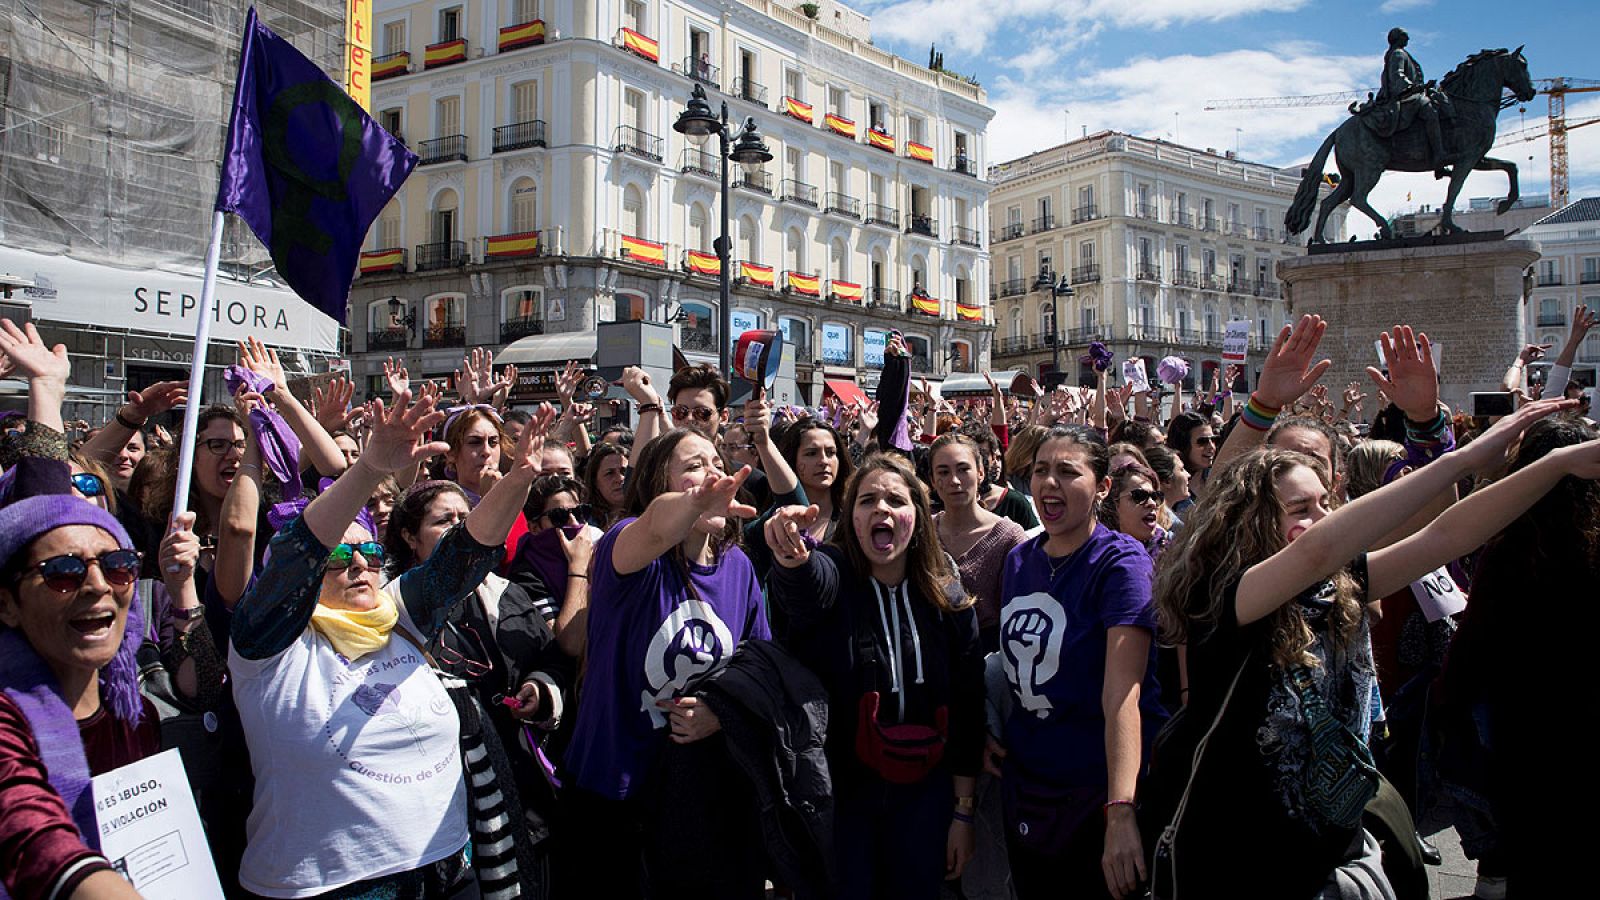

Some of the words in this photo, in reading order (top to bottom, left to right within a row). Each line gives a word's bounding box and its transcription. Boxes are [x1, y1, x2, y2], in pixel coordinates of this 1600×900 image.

[734, 318, 751, 331] Elige
[131, 347, 193, 364] SEPHOR
[1422, 575, 1454, 600] NO
[349, 760, 412, 784] Cuestión
[416, 770, 433, 781] de
[105, 795, 117, 809] ES
